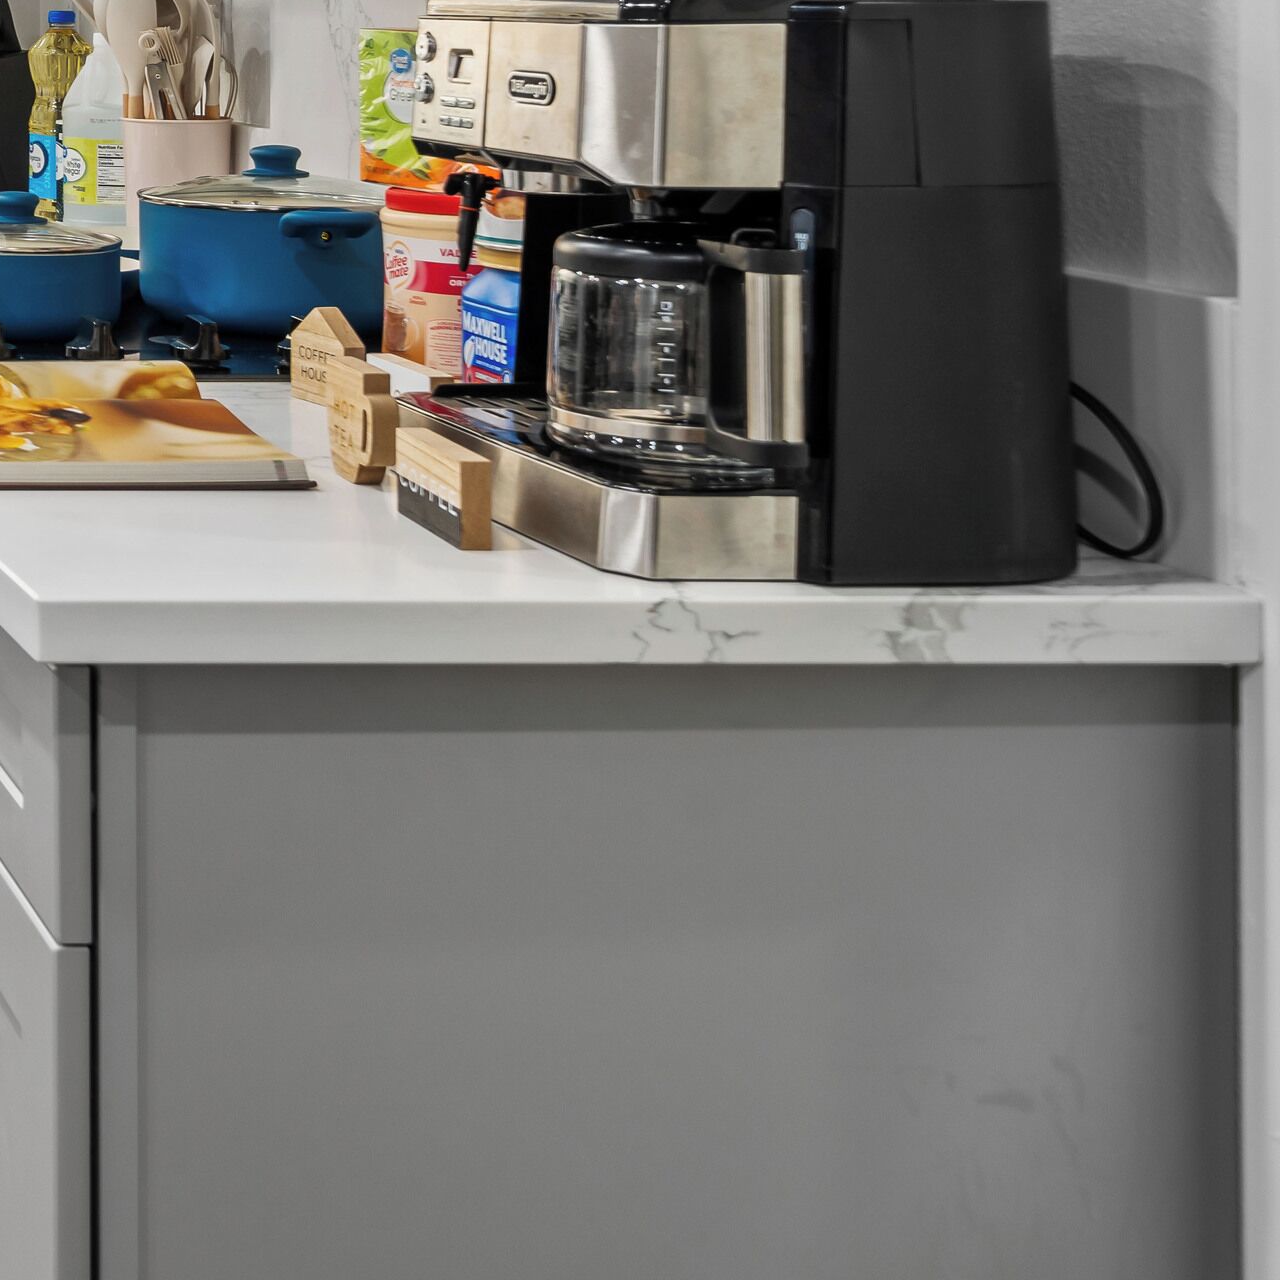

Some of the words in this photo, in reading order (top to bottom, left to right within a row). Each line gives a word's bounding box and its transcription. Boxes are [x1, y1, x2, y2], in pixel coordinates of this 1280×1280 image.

[462, 309, 508, 344] MAXWELL
[475, 335, 508, 365] HOUSE
[300, 366, 328, 384] HOUS
